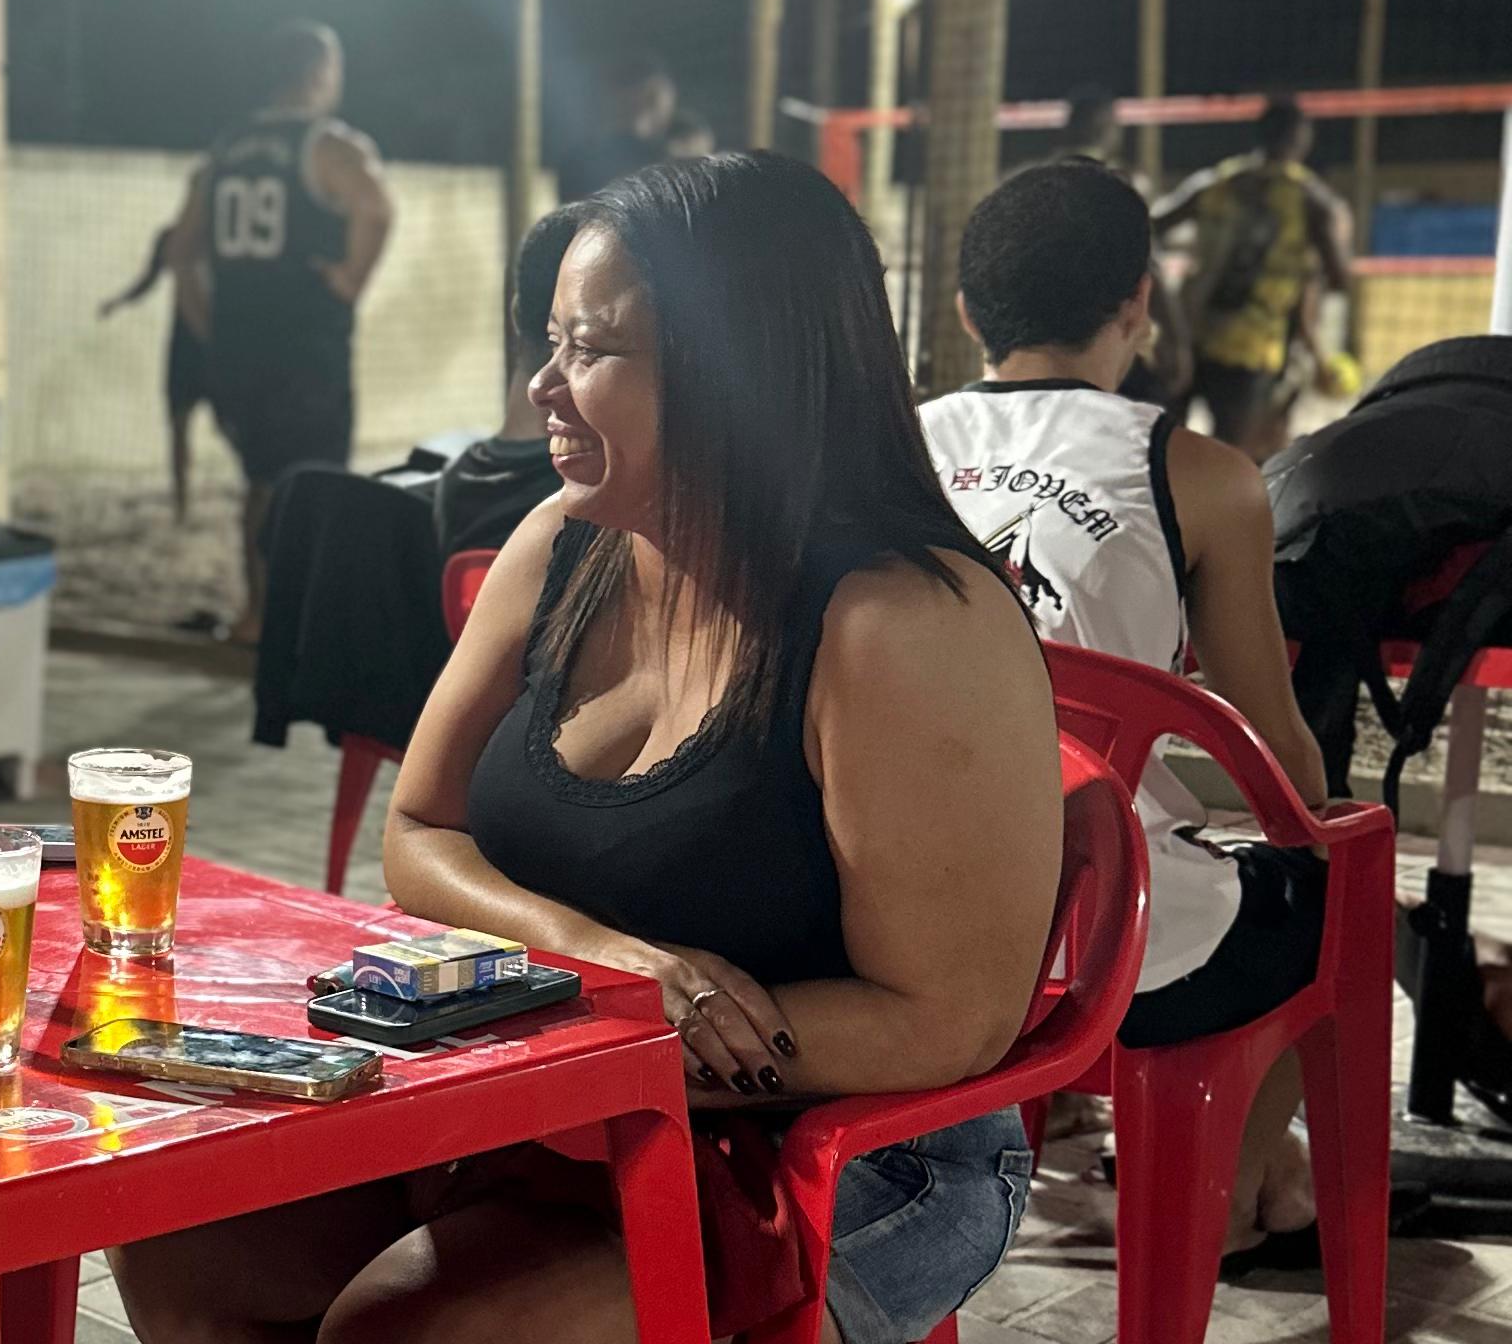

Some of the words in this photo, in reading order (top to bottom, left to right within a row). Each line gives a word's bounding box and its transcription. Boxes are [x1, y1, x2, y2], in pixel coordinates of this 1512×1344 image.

[214, 175, 287, 259] 09
[983, 464, 1119, 542] JOVEM
[119, 827, 165, 840] AMSTEL
[130, 843, 157, 851] LAGER
